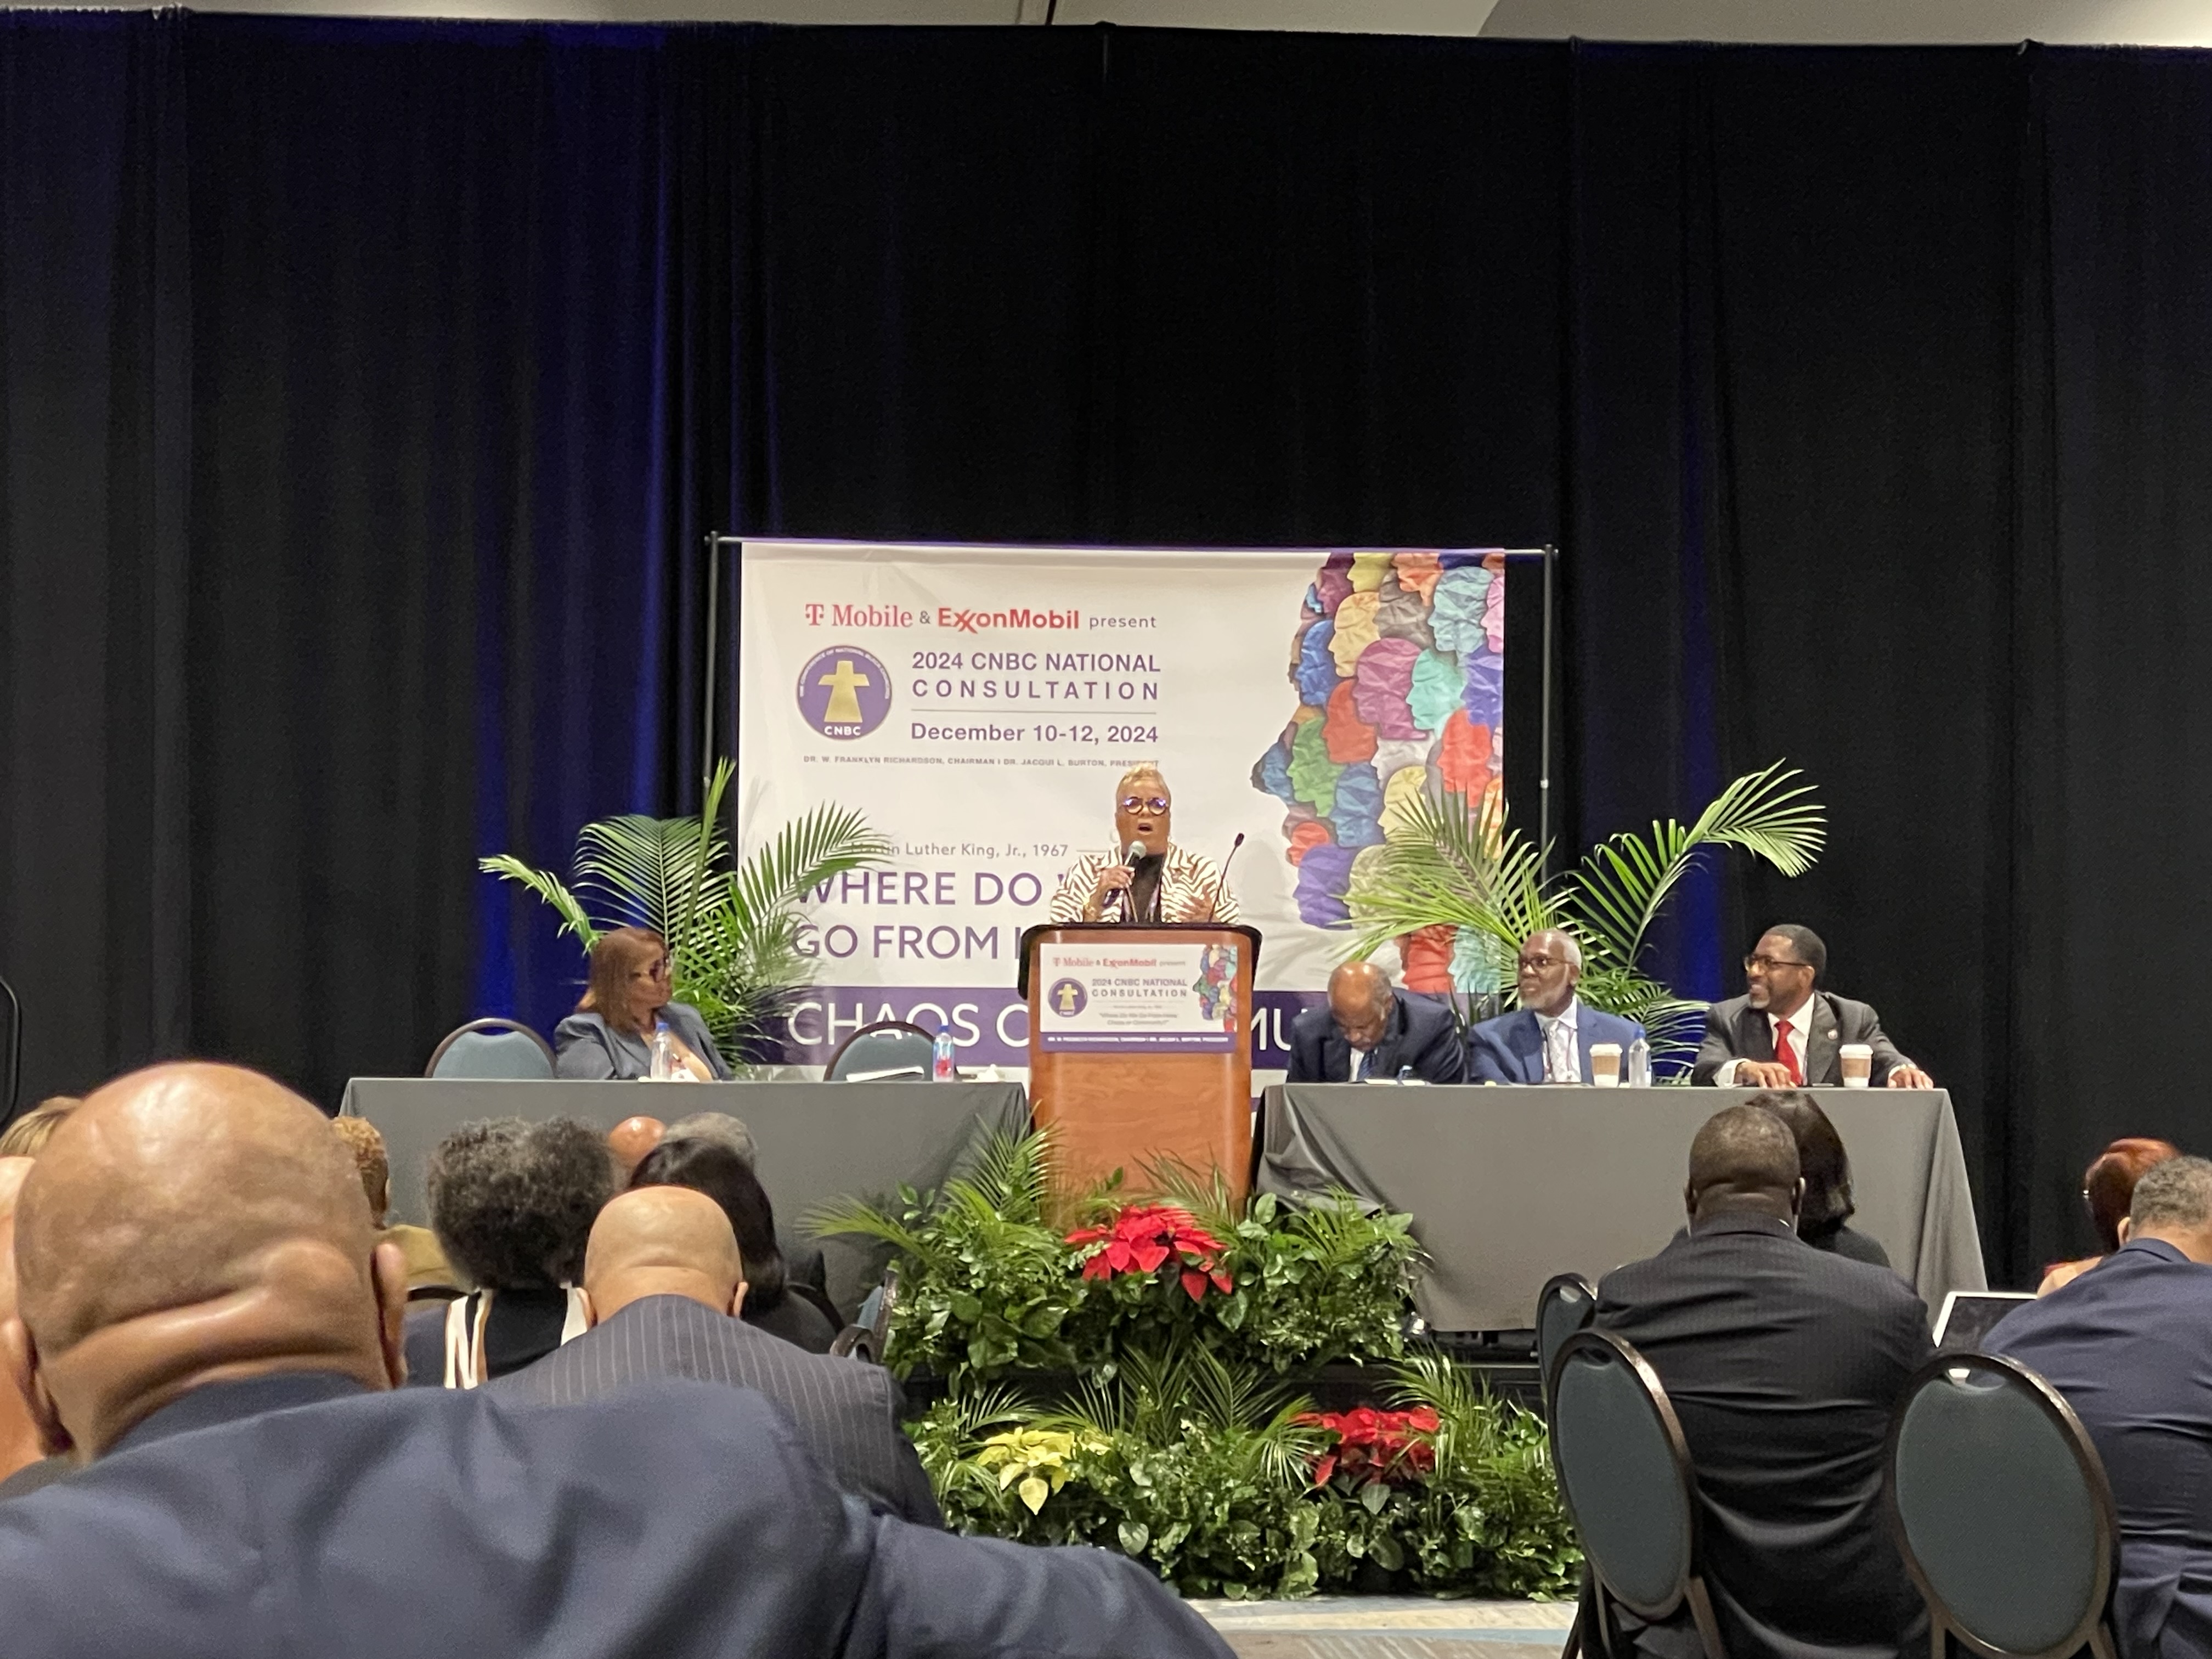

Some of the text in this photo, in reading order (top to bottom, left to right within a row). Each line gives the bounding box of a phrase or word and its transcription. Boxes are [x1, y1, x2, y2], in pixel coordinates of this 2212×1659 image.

[832, 604, 913, 628] Mobile
[919, 611, 930, 624] &
[939, 607, 1079, 634] ExxonMobil
[1089, 616, 1156, 630] present
[912, 652, 1161, 672] 2024 CNBC NATIONAL
[912, 679, 1158, 700] CONSULTATION
[824, 726, 861, 736] CNBC
[911, 723, 1158, 744] December 10-12, 2024
[906, 842, 956, 855] Luther
[962, 843, 1000, 859] King,
[1033, 844, 1069, 857] 1967
[794, 871, 1042, 906] WHERE DO
[791, 924, 858, 958] GO
[873, 925, 998, 960] FROM
[1092, 989, 1187, 997] CONSULTATION
[1143, 979, 1188, 987] NATIONAL
